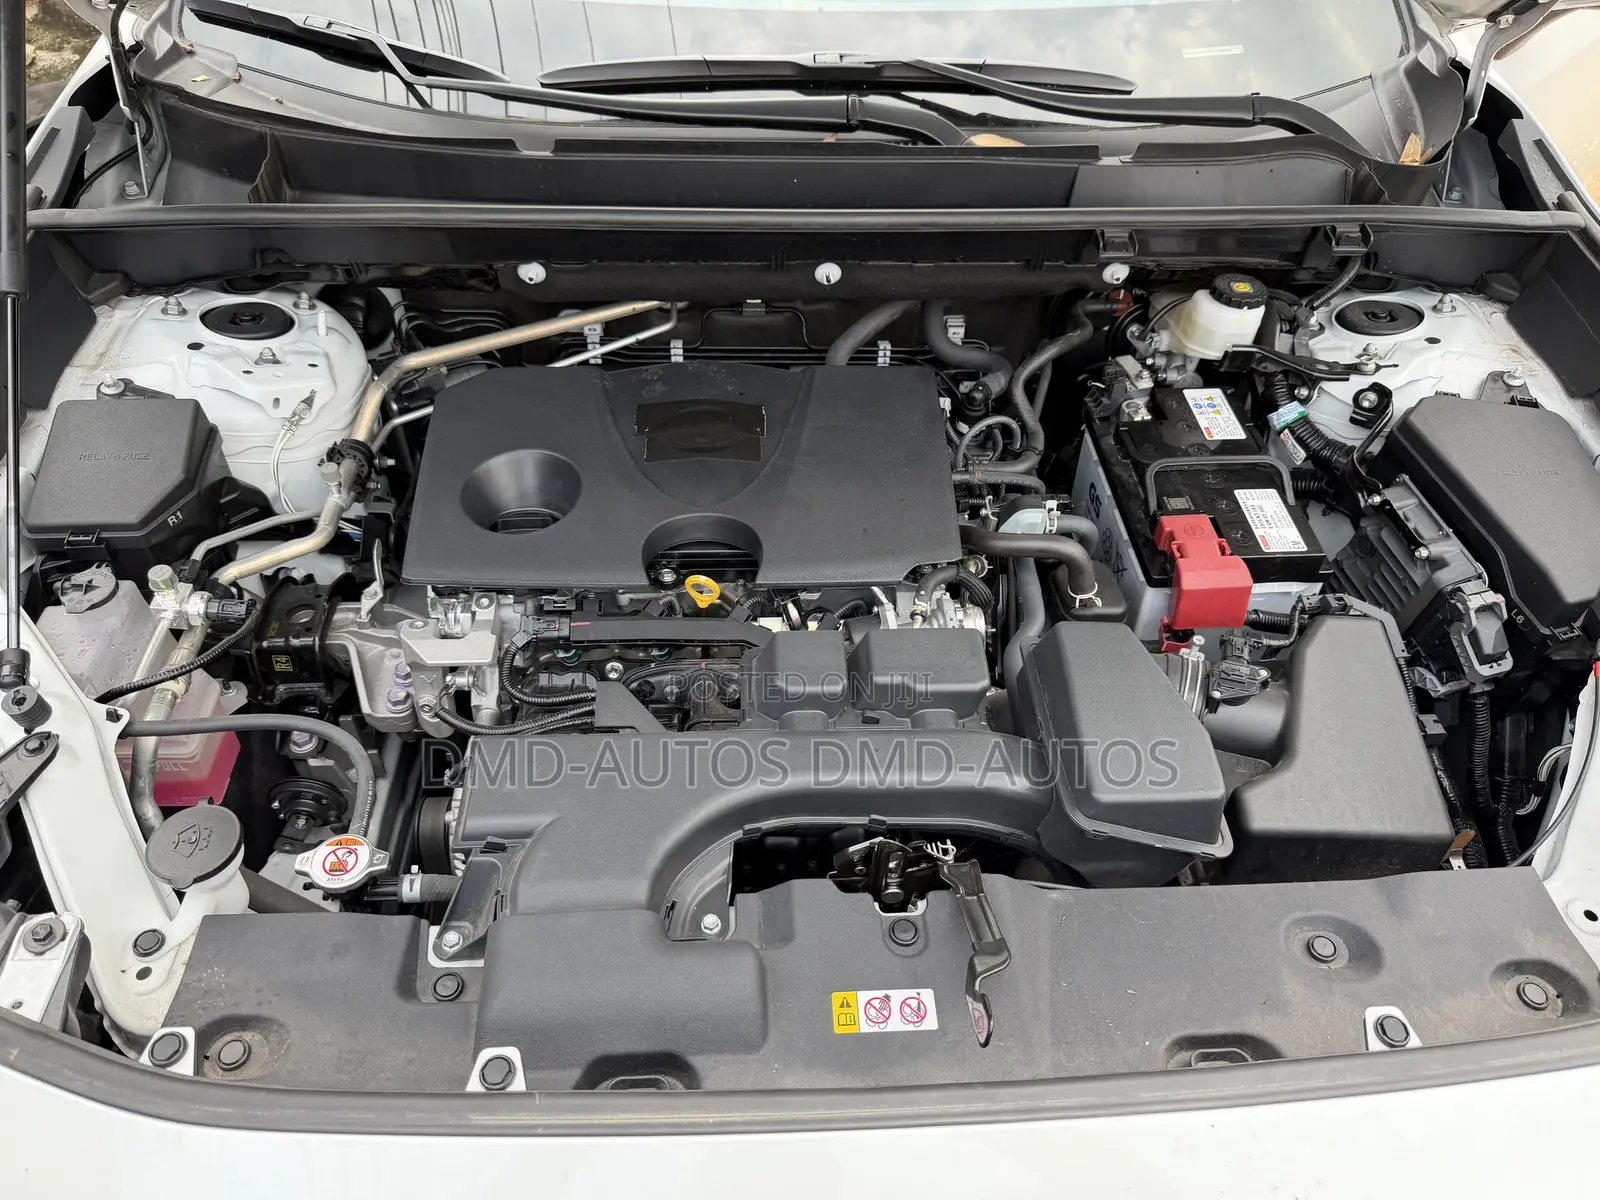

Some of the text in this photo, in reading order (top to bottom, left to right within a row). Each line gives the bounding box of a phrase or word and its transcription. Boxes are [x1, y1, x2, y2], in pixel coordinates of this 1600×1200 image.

[79, 452, 113, 461] RELAY
[123, 452, 151, 460] FUSE
[167, 511, 183, 527] R1
[1511, 608, 1525, 624] L6
[274, 656, 291, 670] R4
